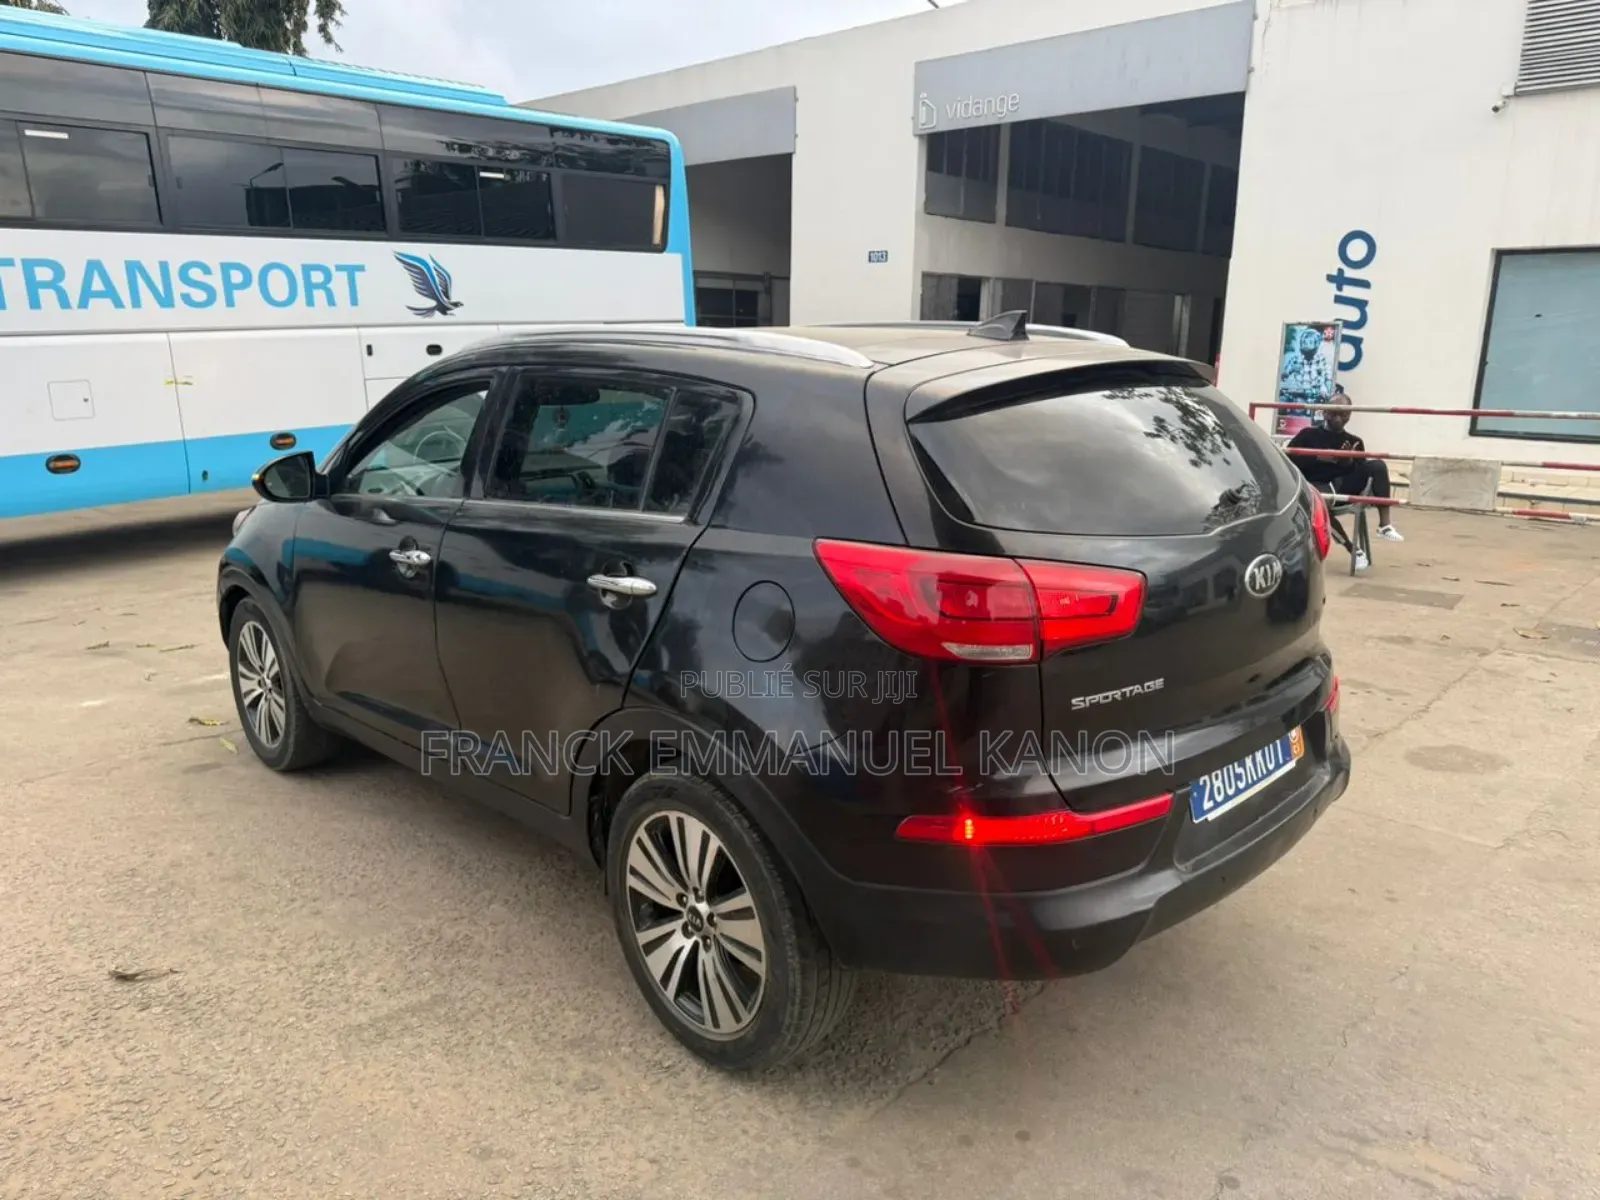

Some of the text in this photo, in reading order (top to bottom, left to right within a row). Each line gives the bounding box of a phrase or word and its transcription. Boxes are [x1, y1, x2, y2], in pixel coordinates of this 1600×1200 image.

[944, 92, 1021, 119] vidange
[1252, 559, 1283, 591] KIA
[1070, 677, 1165, 711] SPORTAGE
